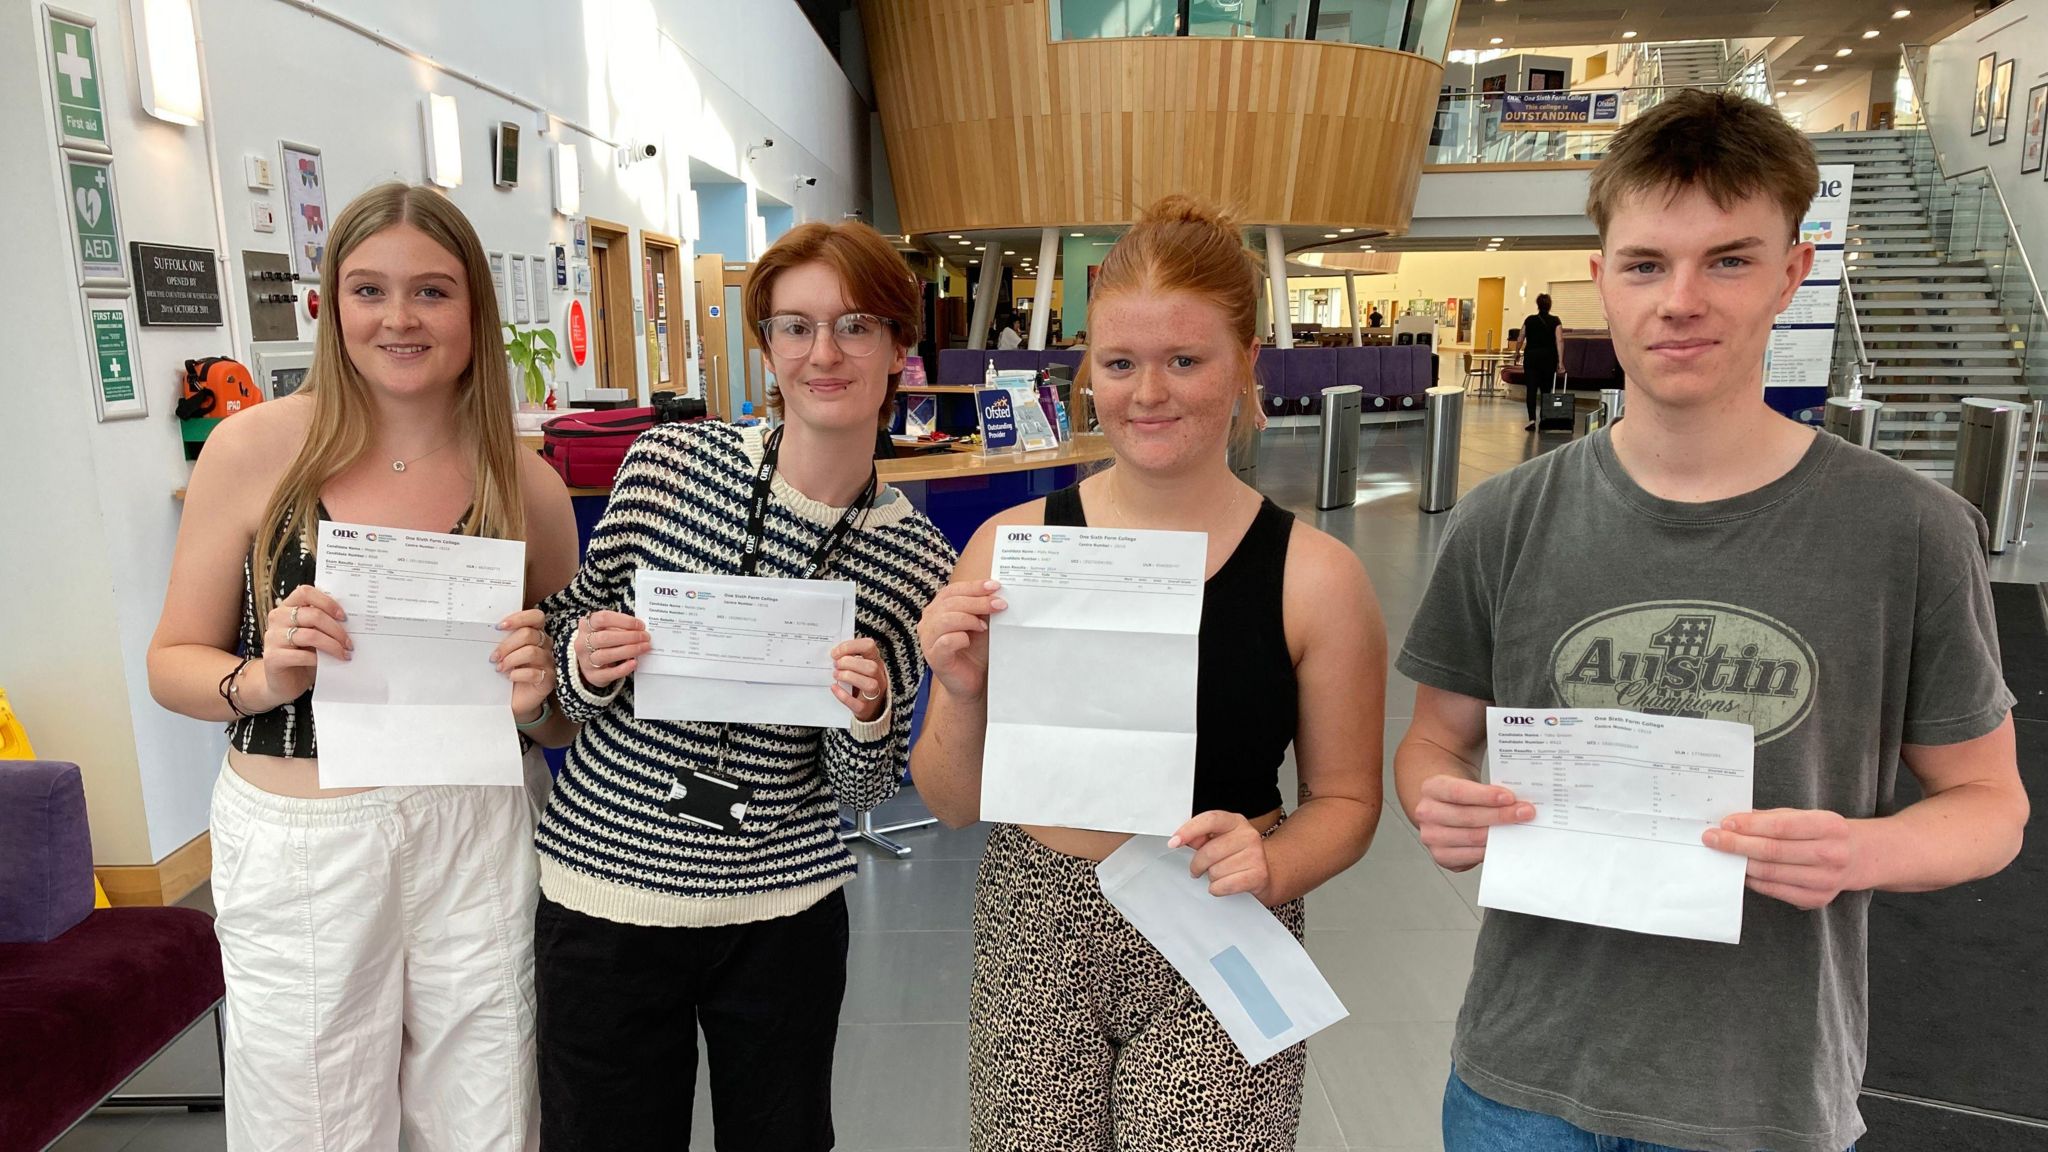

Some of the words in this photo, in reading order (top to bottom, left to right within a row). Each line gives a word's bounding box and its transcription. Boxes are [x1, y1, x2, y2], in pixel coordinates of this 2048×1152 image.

[1505, 111, 1587, 121] OUTSTANDING
[66, 115, 84, 130] First
[85, 119, 98, 132] aid
[1815, 179, 1842, 198] ne
[85, 238, 113, 259] AED
[153, 256, 188, 272] SUFFOLK
[189, 259, 206, 273] ONE
[166, 276, 189, 286] OPENED
[189, 277, 197, 286] BY
[174, 305, 199, 314] OCTOBER
[93, 312, 111, 321] FIRST
[111, 312, 123, 320] AID
[985, 404, 1011, 420] Ofsted
[987, 422, 1013, 431] Outstanding
[988, 431, 1006, 439] Provider
[760, 464, 771, 481] one
[845, 507, 859, 524] one
[333, 528, 358, 538] one
[1008, 532, 1032, 541] one
[745, 534, 756, 554] one
[654, 586, 678, 596] one
[1563, 636, 1801, 698] Austin
[1613, 678, 1740, 716] Champions
[1503, 716, 1535, 725] one
[1642, 720, 1664, 728] College
